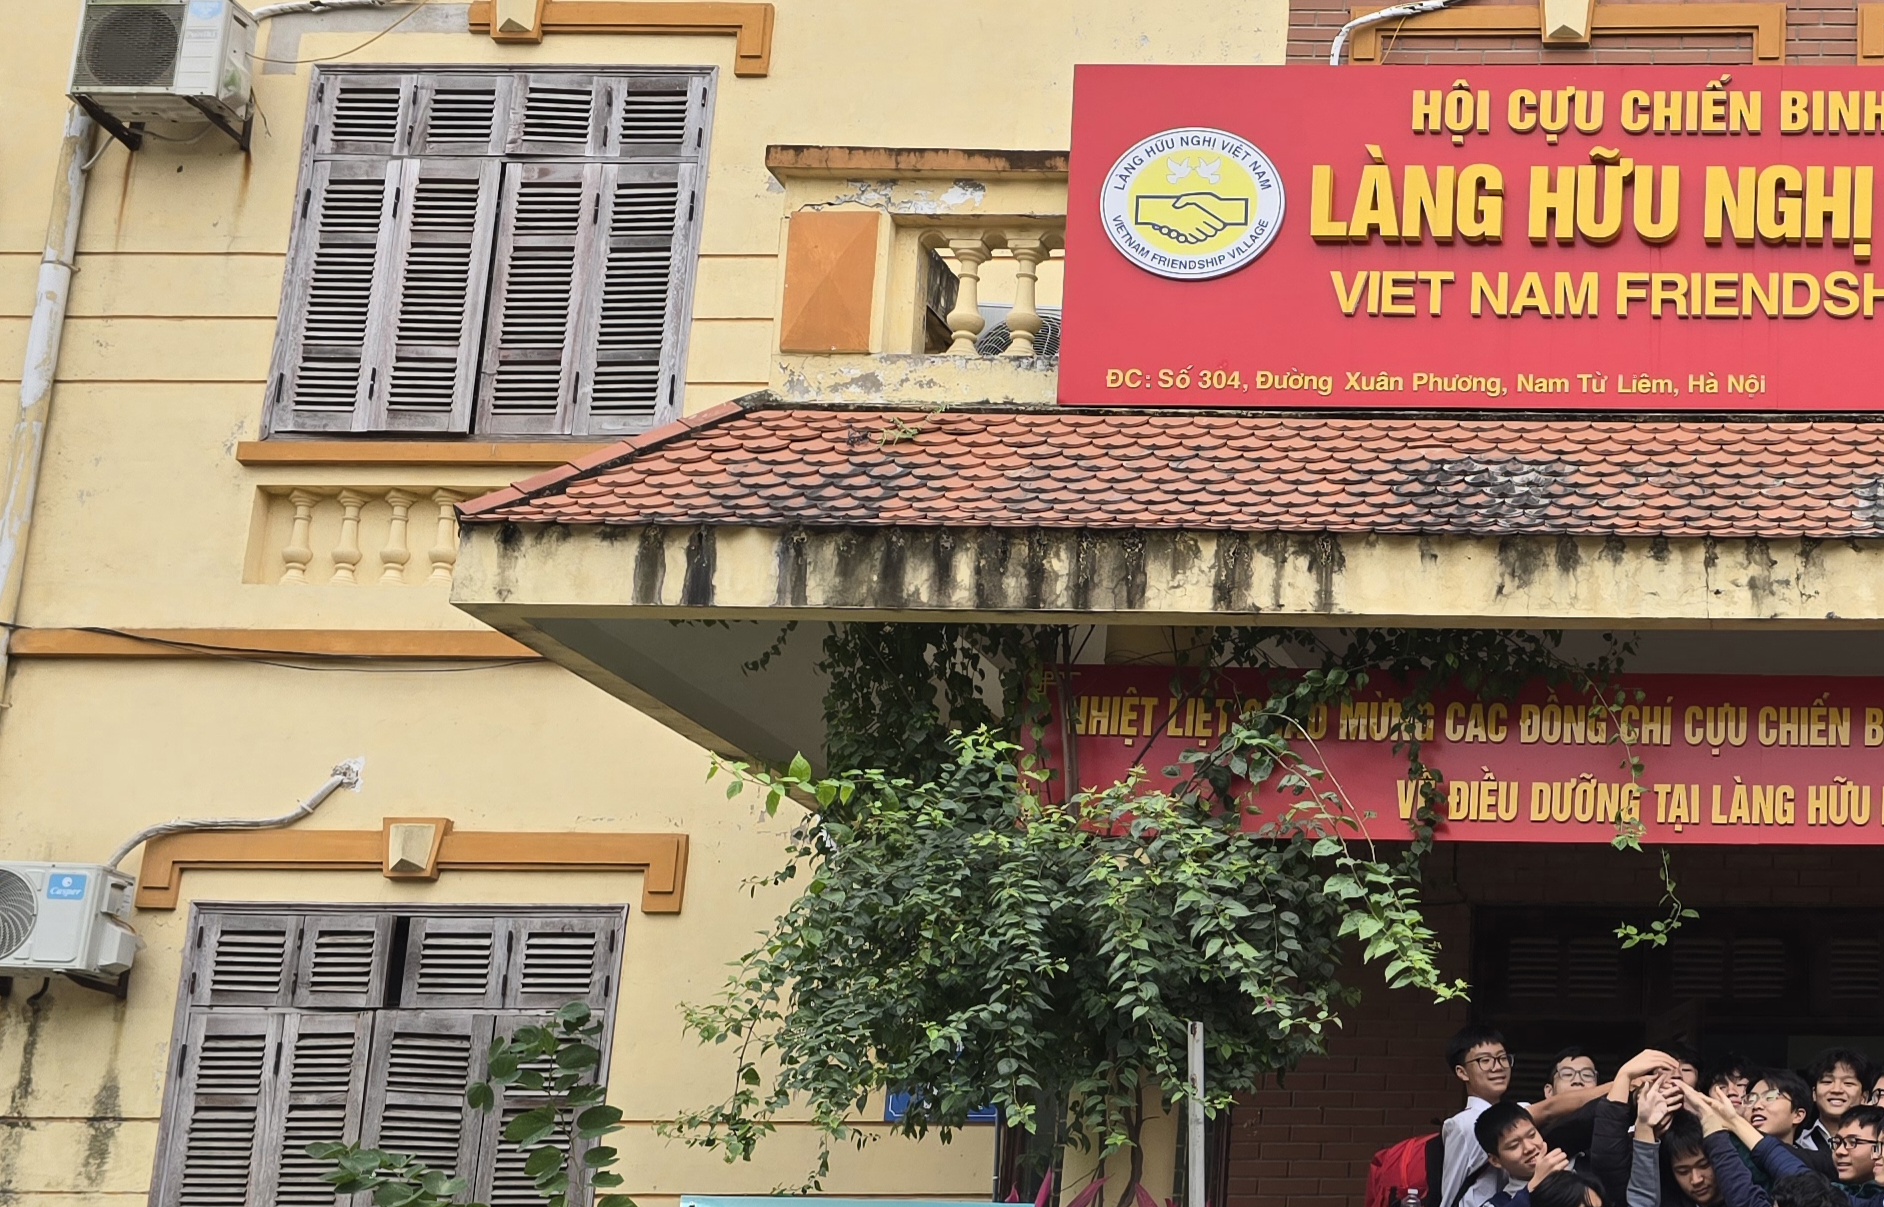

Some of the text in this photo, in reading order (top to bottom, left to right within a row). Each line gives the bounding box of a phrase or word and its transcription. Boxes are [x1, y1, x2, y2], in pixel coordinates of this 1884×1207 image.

[1411, 79, 1490, 146] HỘI
[1507, 84, 1605, 145] CỰU
[1620, 74, 1763, 134] CHIẾN
[1114, 135, 1272, 191] LÀNG HỮU NGHỊ VIỆT NAM
[1310, 144, 1505, 243] LÀNG
[1528, 145, 1682, 245] HỮU
[1703, 164, 1875, 262] NGHỊ
[1112, 214, 1269, 270] VIETNAM FRIENDSHIP VILLAGE
[1330, 270, 1456, 317] VIET
[1470, 271, 1600, 319] NAM
[1106, 365, 1766, 398] ĐC: Số 304, Đường Xuân Phương, Nam Từ Liêm, Hà Nội
[1519, 685, 1607, 745] ĐỒNG
[1620, 696, 1674, 746] CHÍ
[1684, 702, 1749, 757] CỰU
[1758, 691, 1851, 749] CHIẾN
[1447, 765, 1519, 822] ĐIỀU
[1530, 772, 1641, 823] DƯỠNG
[1653, 784, 1701, 833] TẠI
[1710, 764, 1797, 825] LÀNG
[1806, 776, 1873, 827] HỮU
